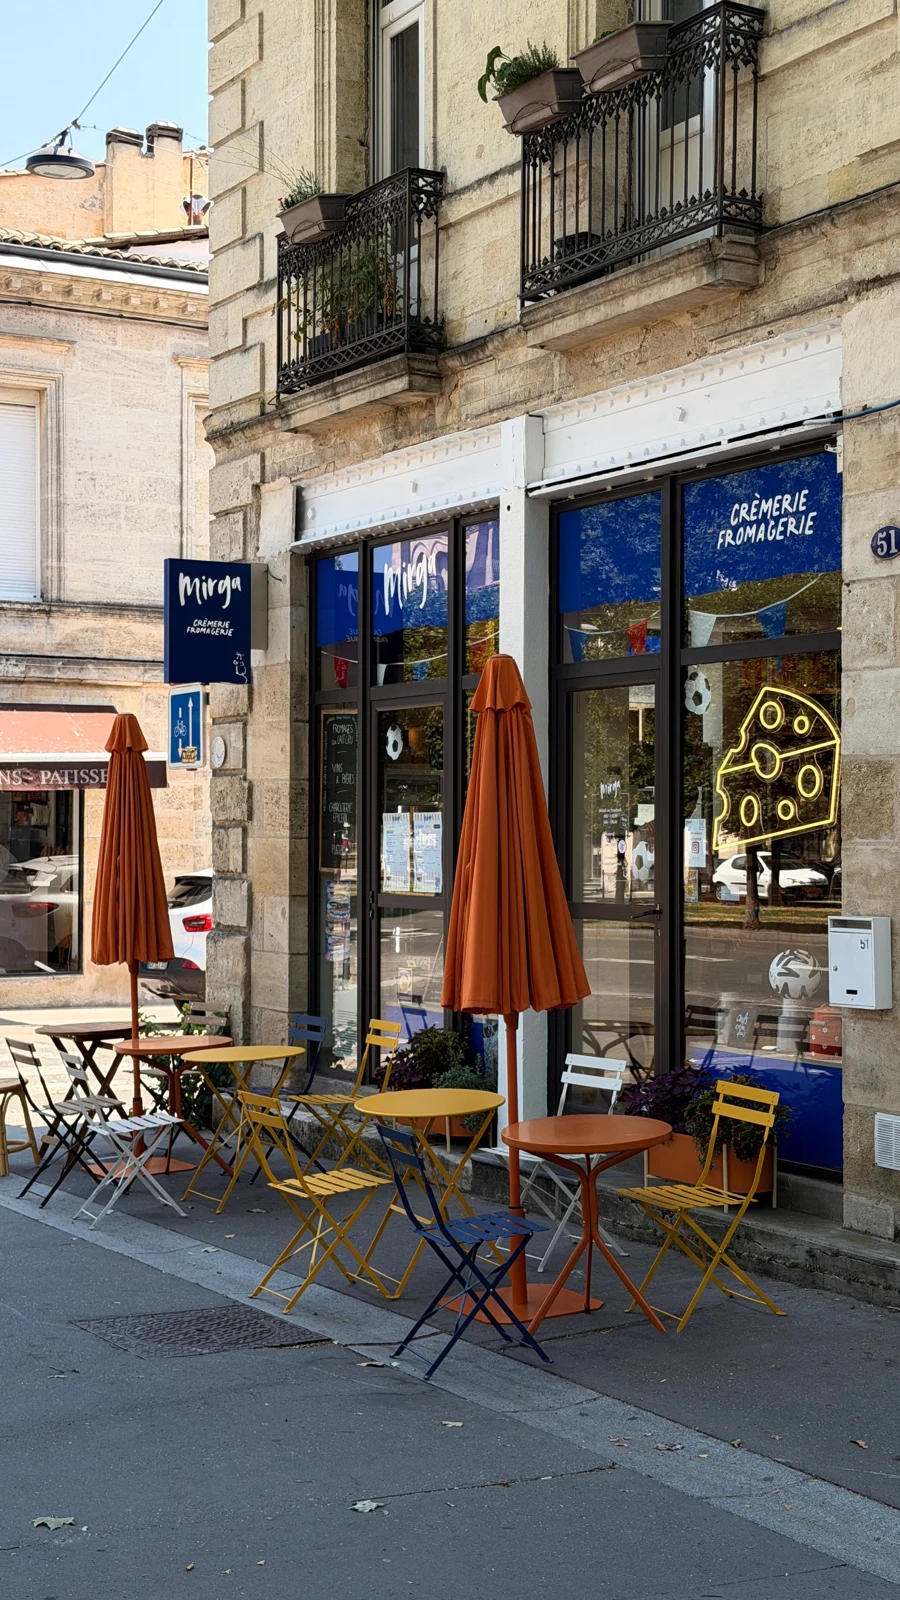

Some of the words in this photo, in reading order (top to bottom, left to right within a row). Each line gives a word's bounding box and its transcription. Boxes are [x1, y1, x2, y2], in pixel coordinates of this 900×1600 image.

[730, 490, 809, 526] CRÈMERIE
[717, 512, 817, 549] FROMAGERIE
[877, 530, 898, 556] 51
[179, 572, 242, 609] Mirga
[384, 552, 437, 616] Mirga
[186, 626, 234, 636] FROMAGERIE
[193, 618, 231, 629] CRÈMERIE
[331, 763, 343, 773] VINS
[860, 938, 869, 950] 51
